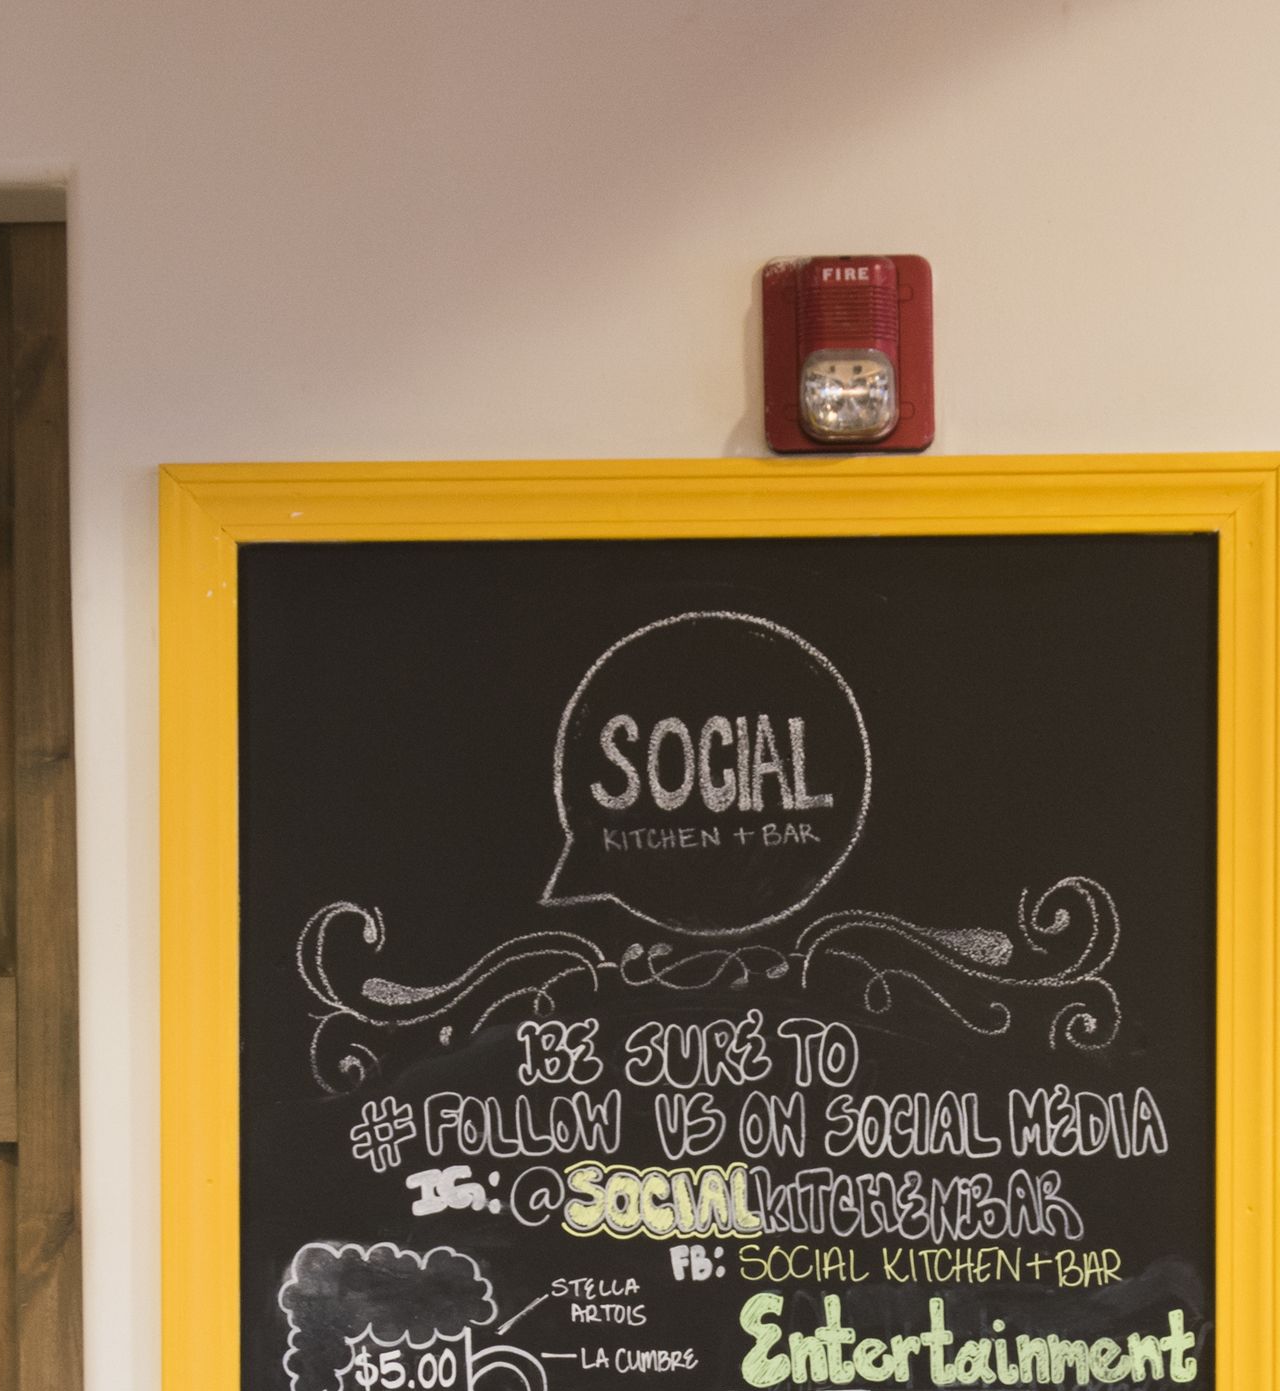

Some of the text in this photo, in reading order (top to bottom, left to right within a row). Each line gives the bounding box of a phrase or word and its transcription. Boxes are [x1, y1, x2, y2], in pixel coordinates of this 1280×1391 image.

[822, 267, 870, 281] FIRE
[590, 714, 834, 812] SOCIAL
[603, 827, 721, 851] KITCHEN
[762, 822, 821, 847] BAR
[517, 1009, 859, 1088] BE SURE TO
[655, 1091, 727, 1160] US
[739, 1090, 806, 1158] ON
[824, 1090, 1001, 1158] SOCIAL
[1009, 1084, 1169, 1158] MEDIA
[669, 1244, 727, 1282] FB:
[739, 1244, 869, 1282] SOCIAL
[551, 1278, 640, 1300] STELLA
[571, 1303, 648, 1326] ARTOIS
[739, 1292, 1198, 1388] Entertainment
[354, 1346, 457, 1391] $5.00
[580, 1347, 699, 1373] LA CUMBRE
